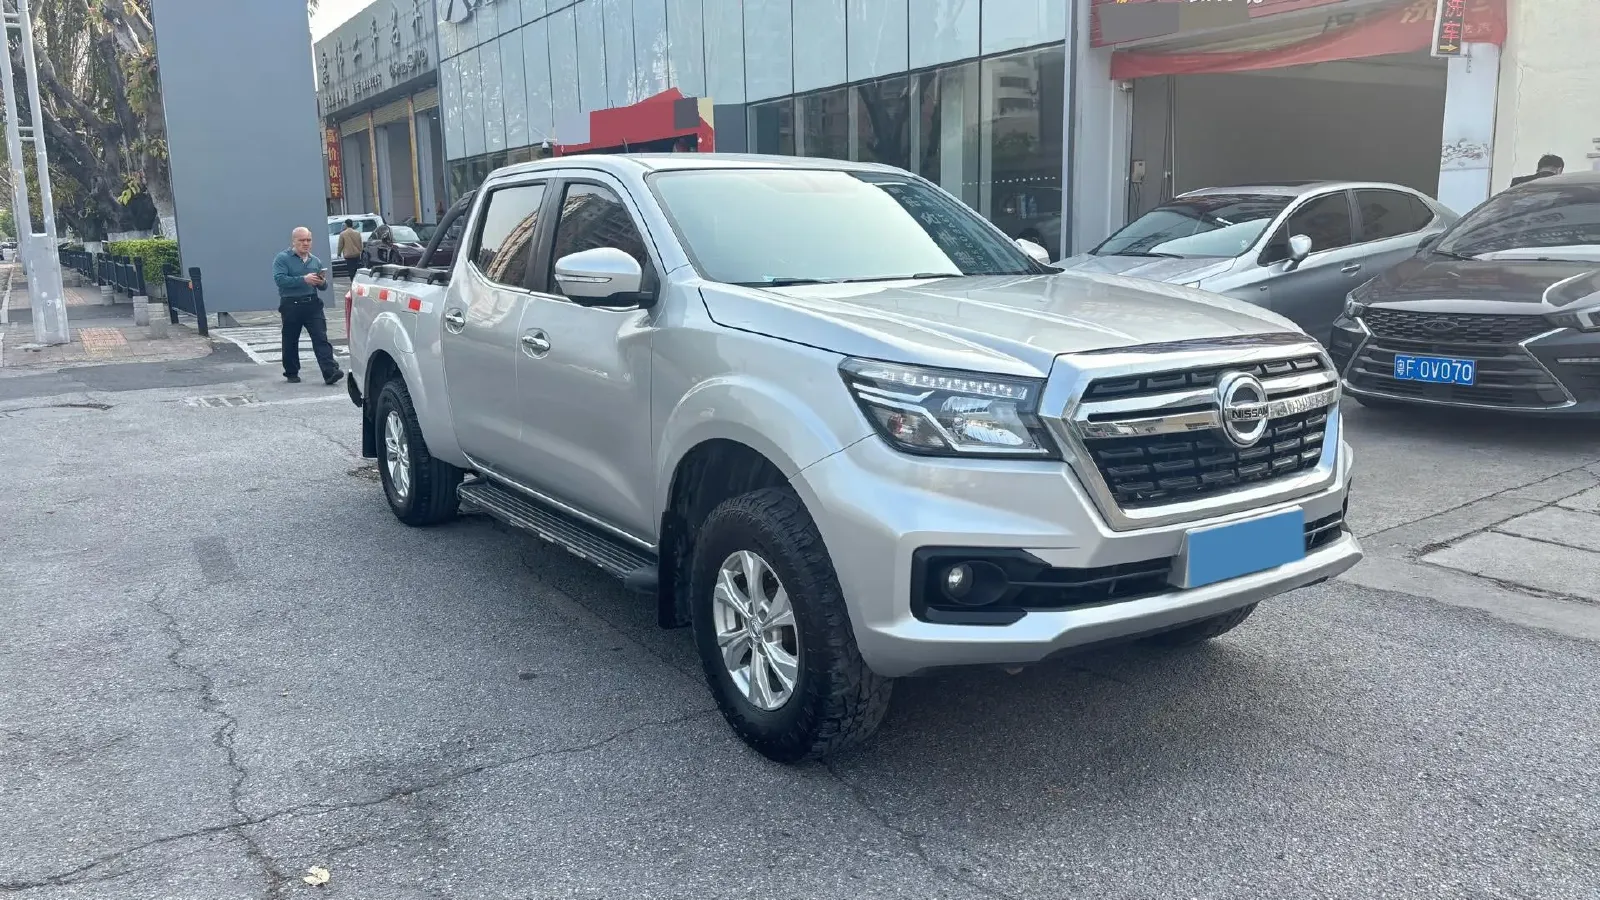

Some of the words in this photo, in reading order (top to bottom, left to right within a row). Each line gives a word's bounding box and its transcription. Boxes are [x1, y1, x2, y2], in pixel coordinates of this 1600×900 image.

[327, 129, 340, 197] 高价收车
[1231, 407, 1268, 418] NISSAN
